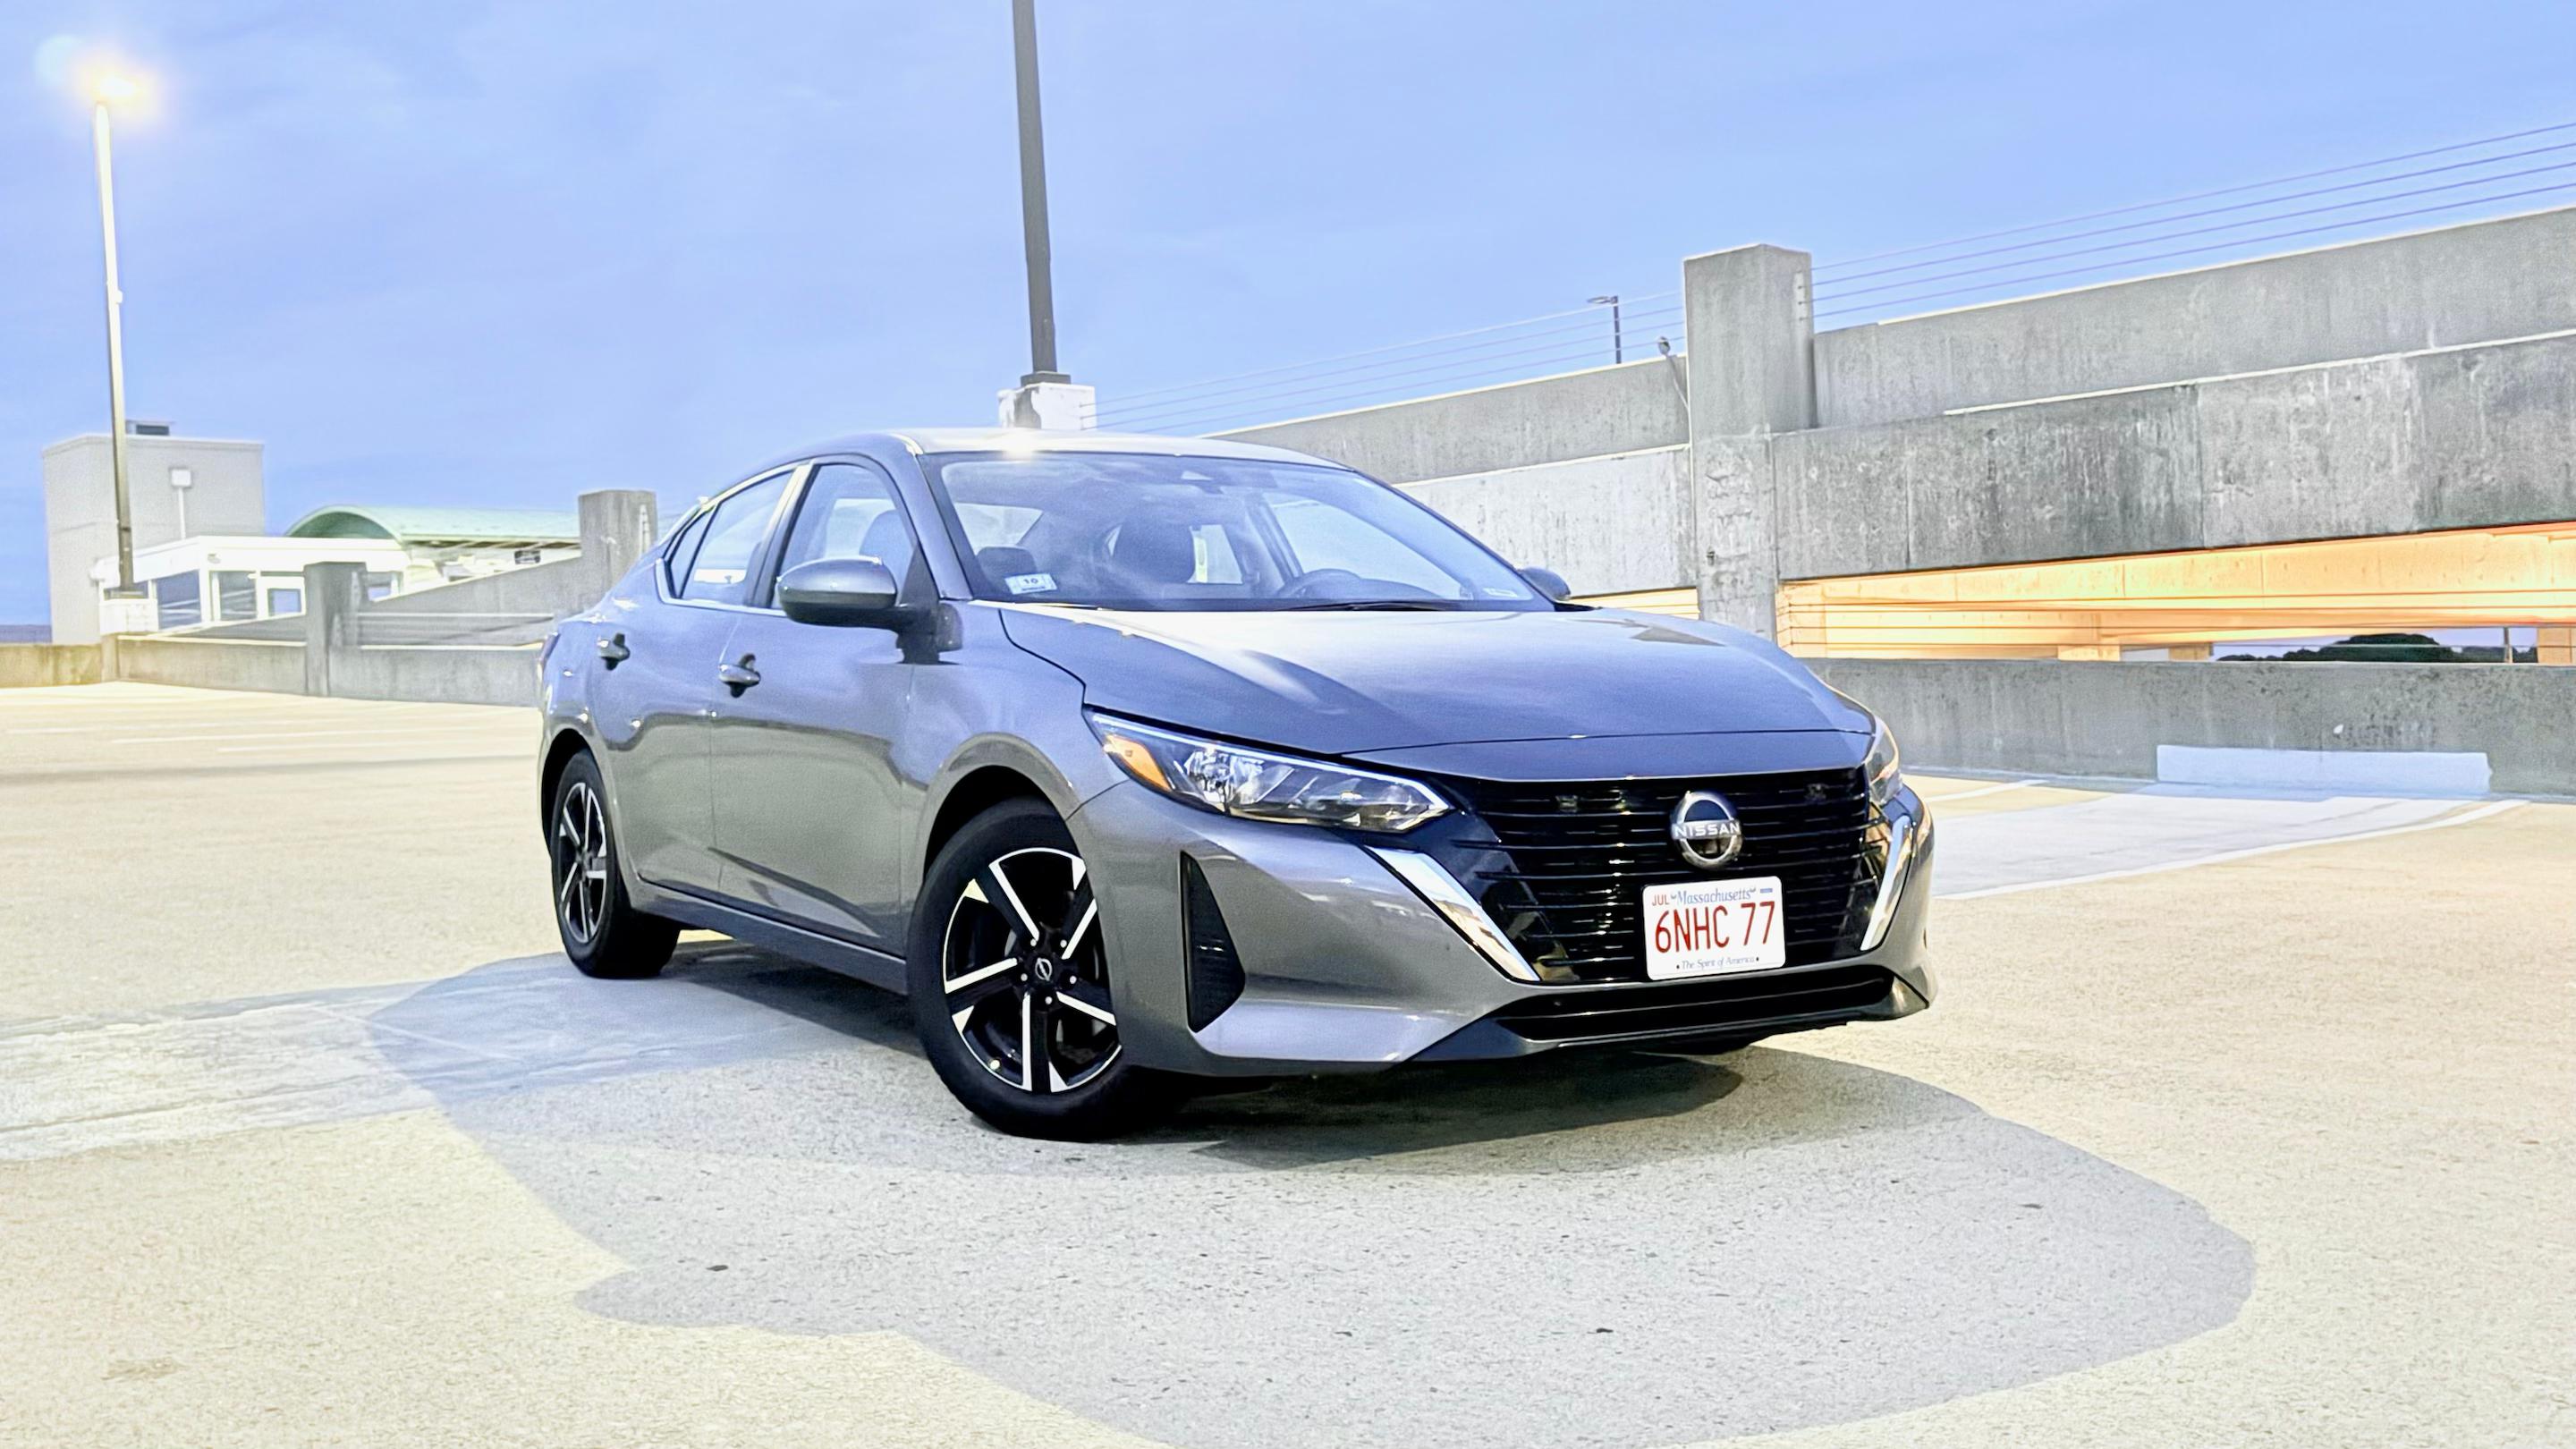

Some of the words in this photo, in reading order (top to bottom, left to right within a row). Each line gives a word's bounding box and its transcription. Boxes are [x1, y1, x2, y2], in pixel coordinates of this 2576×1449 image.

[1674, 823, 1740, 837] NISSAN
[1652, 894, 1670, 906] JUL
[1677, 888, 1751, 905] Massachusetts
[1656, 905, 1730, 953] 6NHC
[1741, 901, 1775, 945] 77
[1682, 960, 1693, 969] The
[1697, 958, 1715, 970] Spirit
[1725, 956, 1754, 966] America
